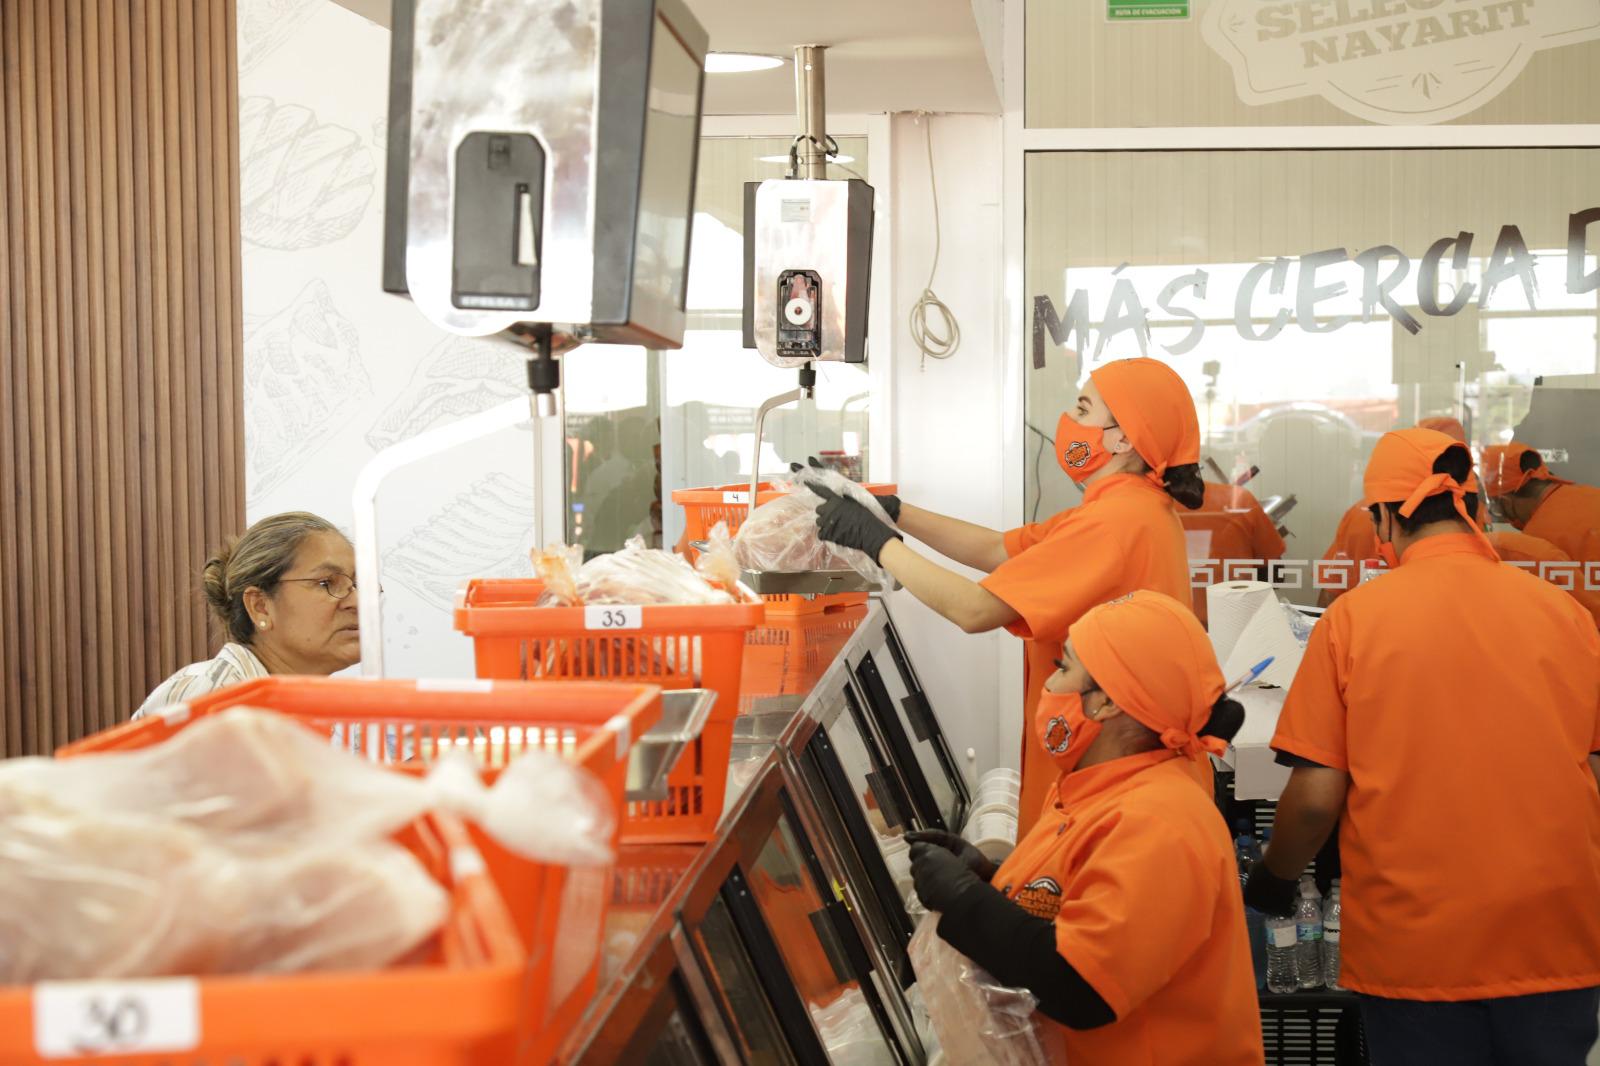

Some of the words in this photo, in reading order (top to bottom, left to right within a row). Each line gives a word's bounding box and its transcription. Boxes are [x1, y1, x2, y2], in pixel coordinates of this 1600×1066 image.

[1255, 0, 1444, 42] SELE
[1301, 0, 1534, 68] NAYARIT
[1033, 262, 1209, 378] MÁS
[1234, 225, 1538, 341] CERCA
[602, 610, 626, 627] 35
